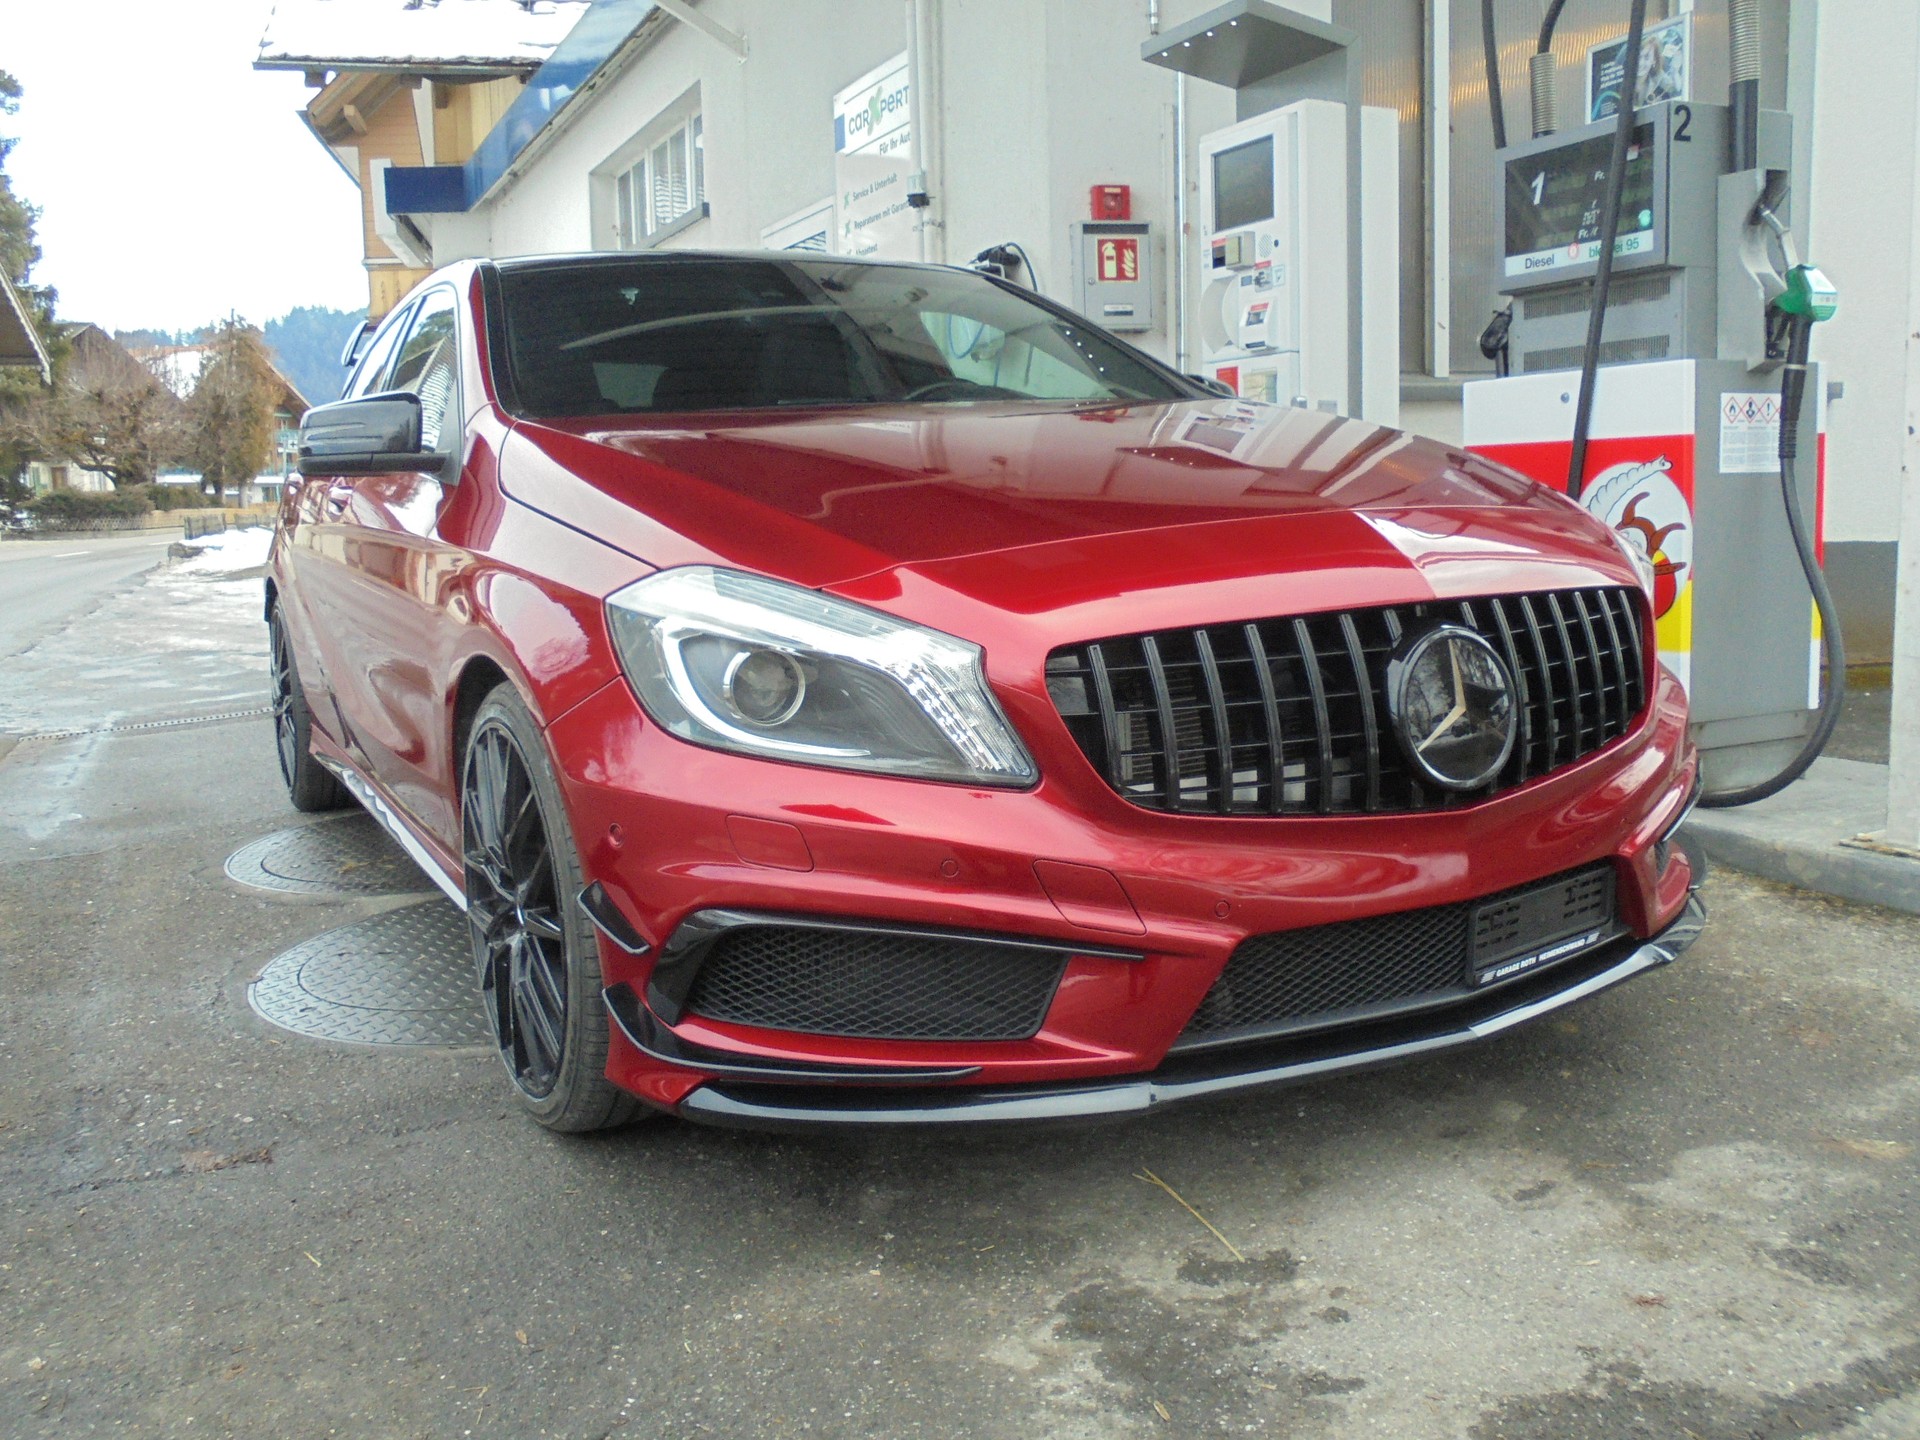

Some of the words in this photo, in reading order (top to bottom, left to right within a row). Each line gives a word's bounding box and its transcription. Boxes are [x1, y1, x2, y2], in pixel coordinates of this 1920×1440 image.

[1673, 104, 1692, 142] 2
[880, 142, 889, 155] Für
[890, 137, 898, 150] Ihr
[900, 131, 911, 145] Aut
[853, 187, 869, 201] Service
[874, 172, 897, 191] Unterhalt
[1531, 171, 1545, 206] 1
[854, 212, 882, 230] Reparaturen
[882, 207, 891, 218] mit
[891, 200, 910, 214] Garant
[1626, 237, 1640, 251] 95
[1525, 253, 1555, 270] Diesel
[1497, 963, 1520, 977] GARAGE
[1521, 956, 1536, 968] ROTH
